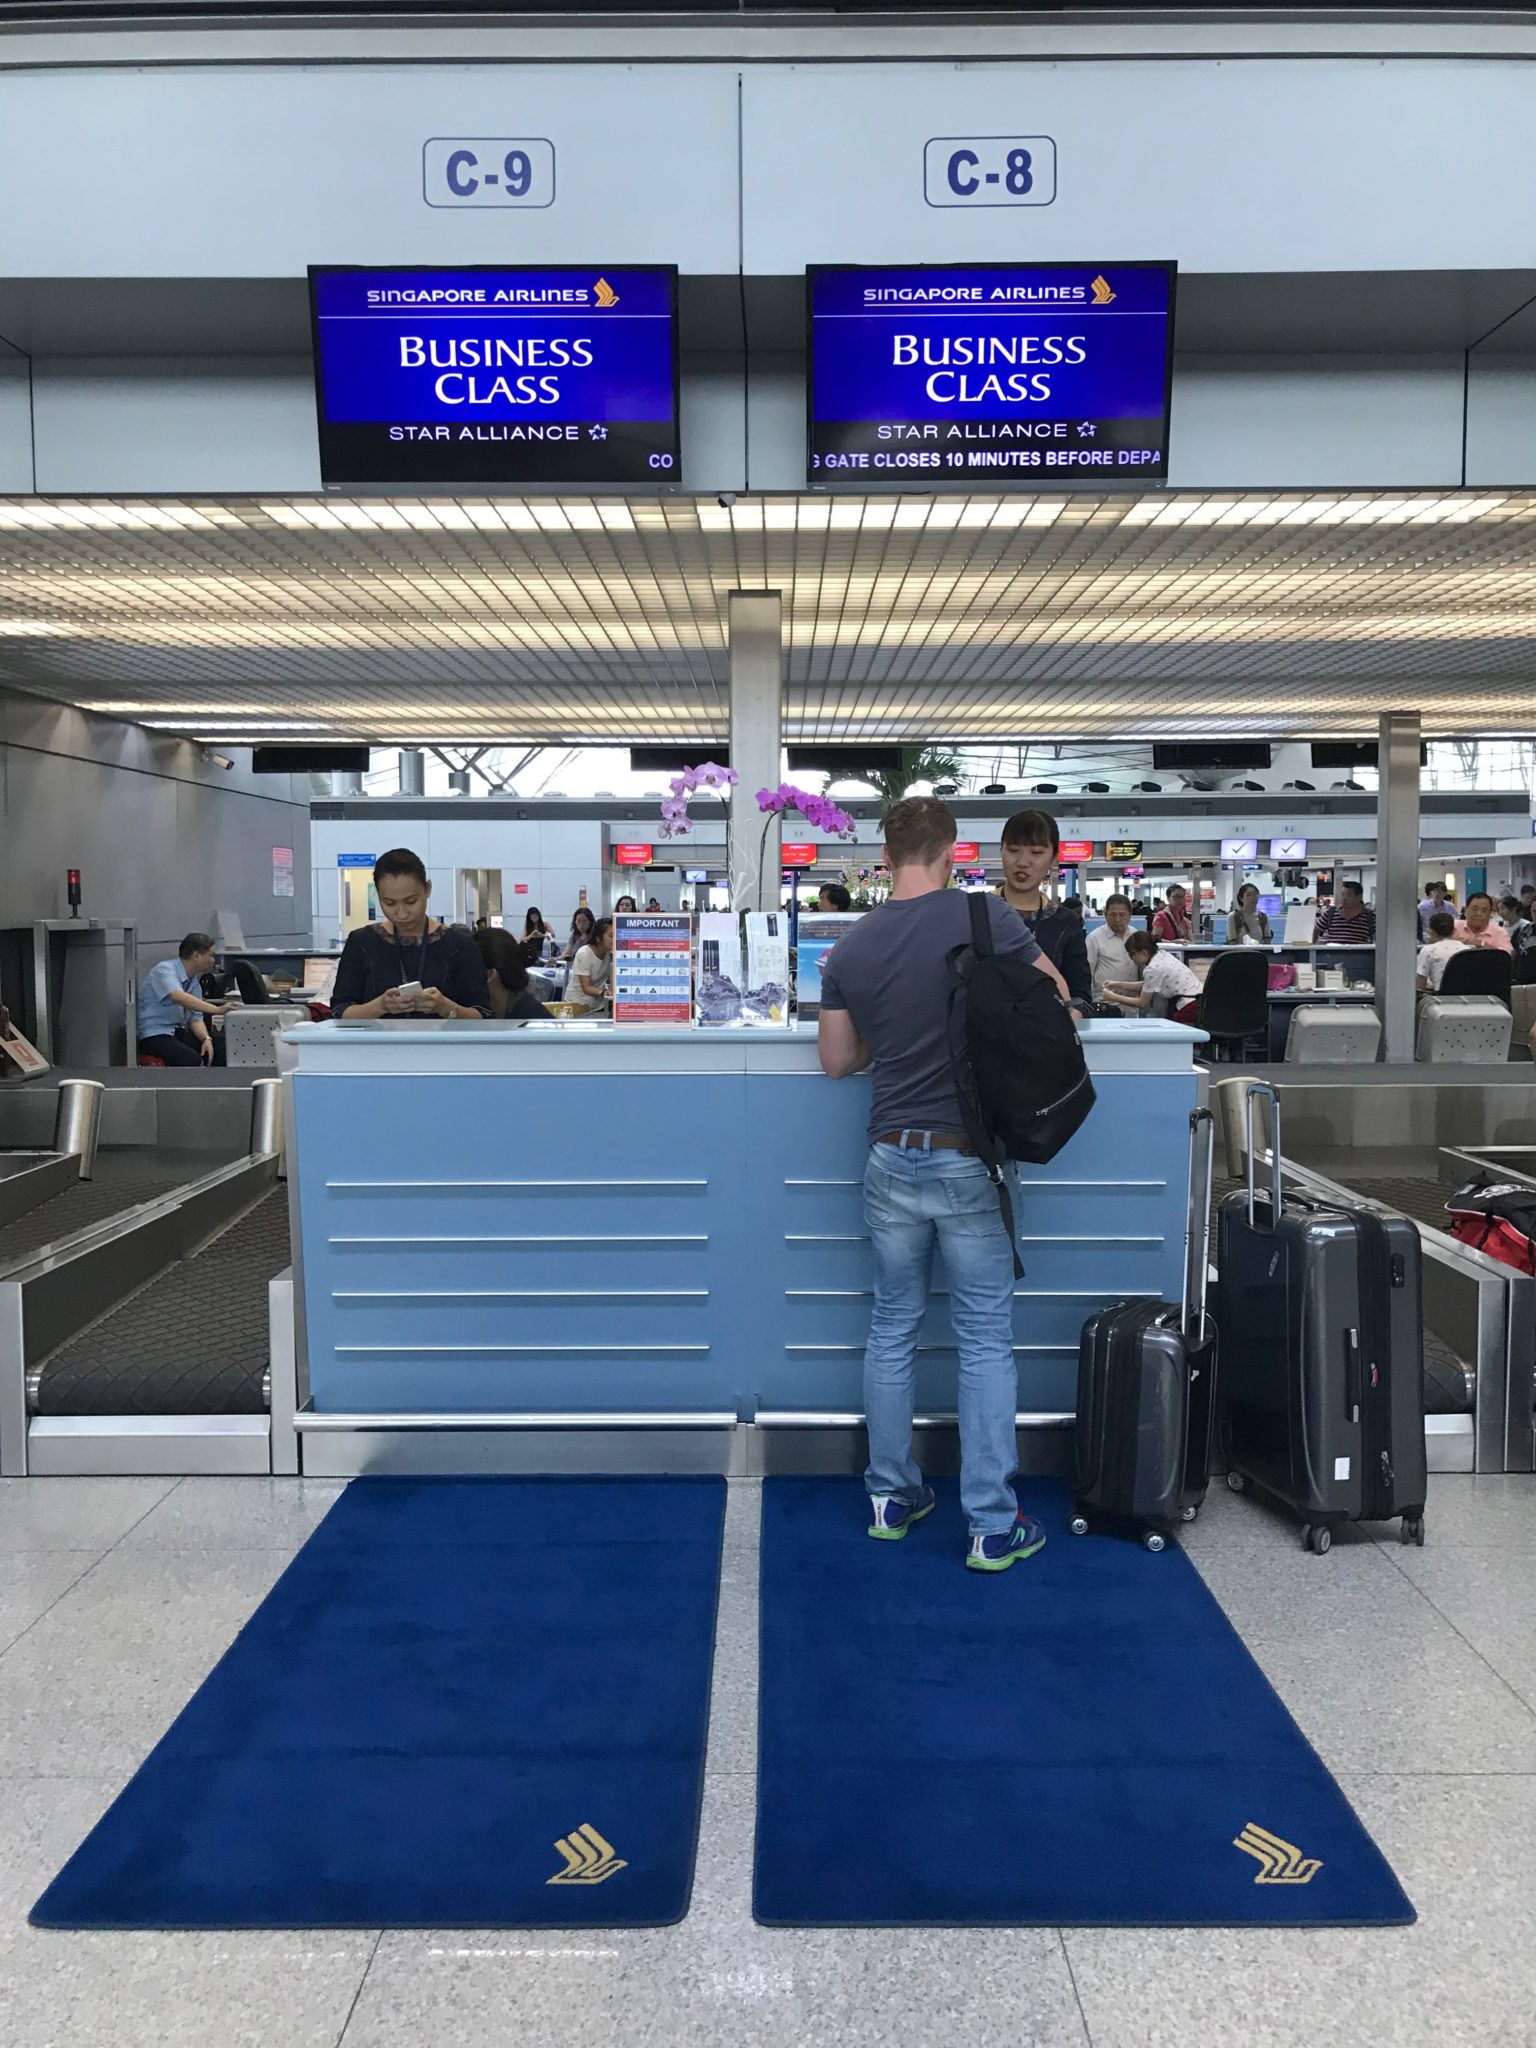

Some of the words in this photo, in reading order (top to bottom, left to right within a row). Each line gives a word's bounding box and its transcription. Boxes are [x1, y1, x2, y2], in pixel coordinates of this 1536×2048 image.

[446, 149, 532, 197] C-9
[947, 148, 1034, 197] C-8
[366, 289, 487, 303] SINGAPORE
[493, 288, 589, 302] AIRLINES
[863, 287, 983, 301] SINGAPORE
[990, 286, 1085, 300] AIRLINES
[399, 336, 593, 368] BUSINESS
[892, 334, 1087, 366] BUSINESS
[434, 372, 560, 405] CLASS
[925, 371, 1051, 403] CLASS
[389, 426, 451, 441] STAR
[458, 425, 580, 441] ALLIANCE
[877, 424, 939, 440] STAR
[946, 423, 1068, 439] ALLIANCE
[648, 453, 674, 469] CO
[824, 452, 870, 468] GATE
[873, 451, 942, 468] CLOSES
[945, 451, 964, 467] 10
[967, 451, 1042, 467] MINUTES
[1045, 450, 1114, 466] BEFORE
[1117, 450, 1161, 465] DEPA
[626, 919, 680, 928] IMPORTANT
